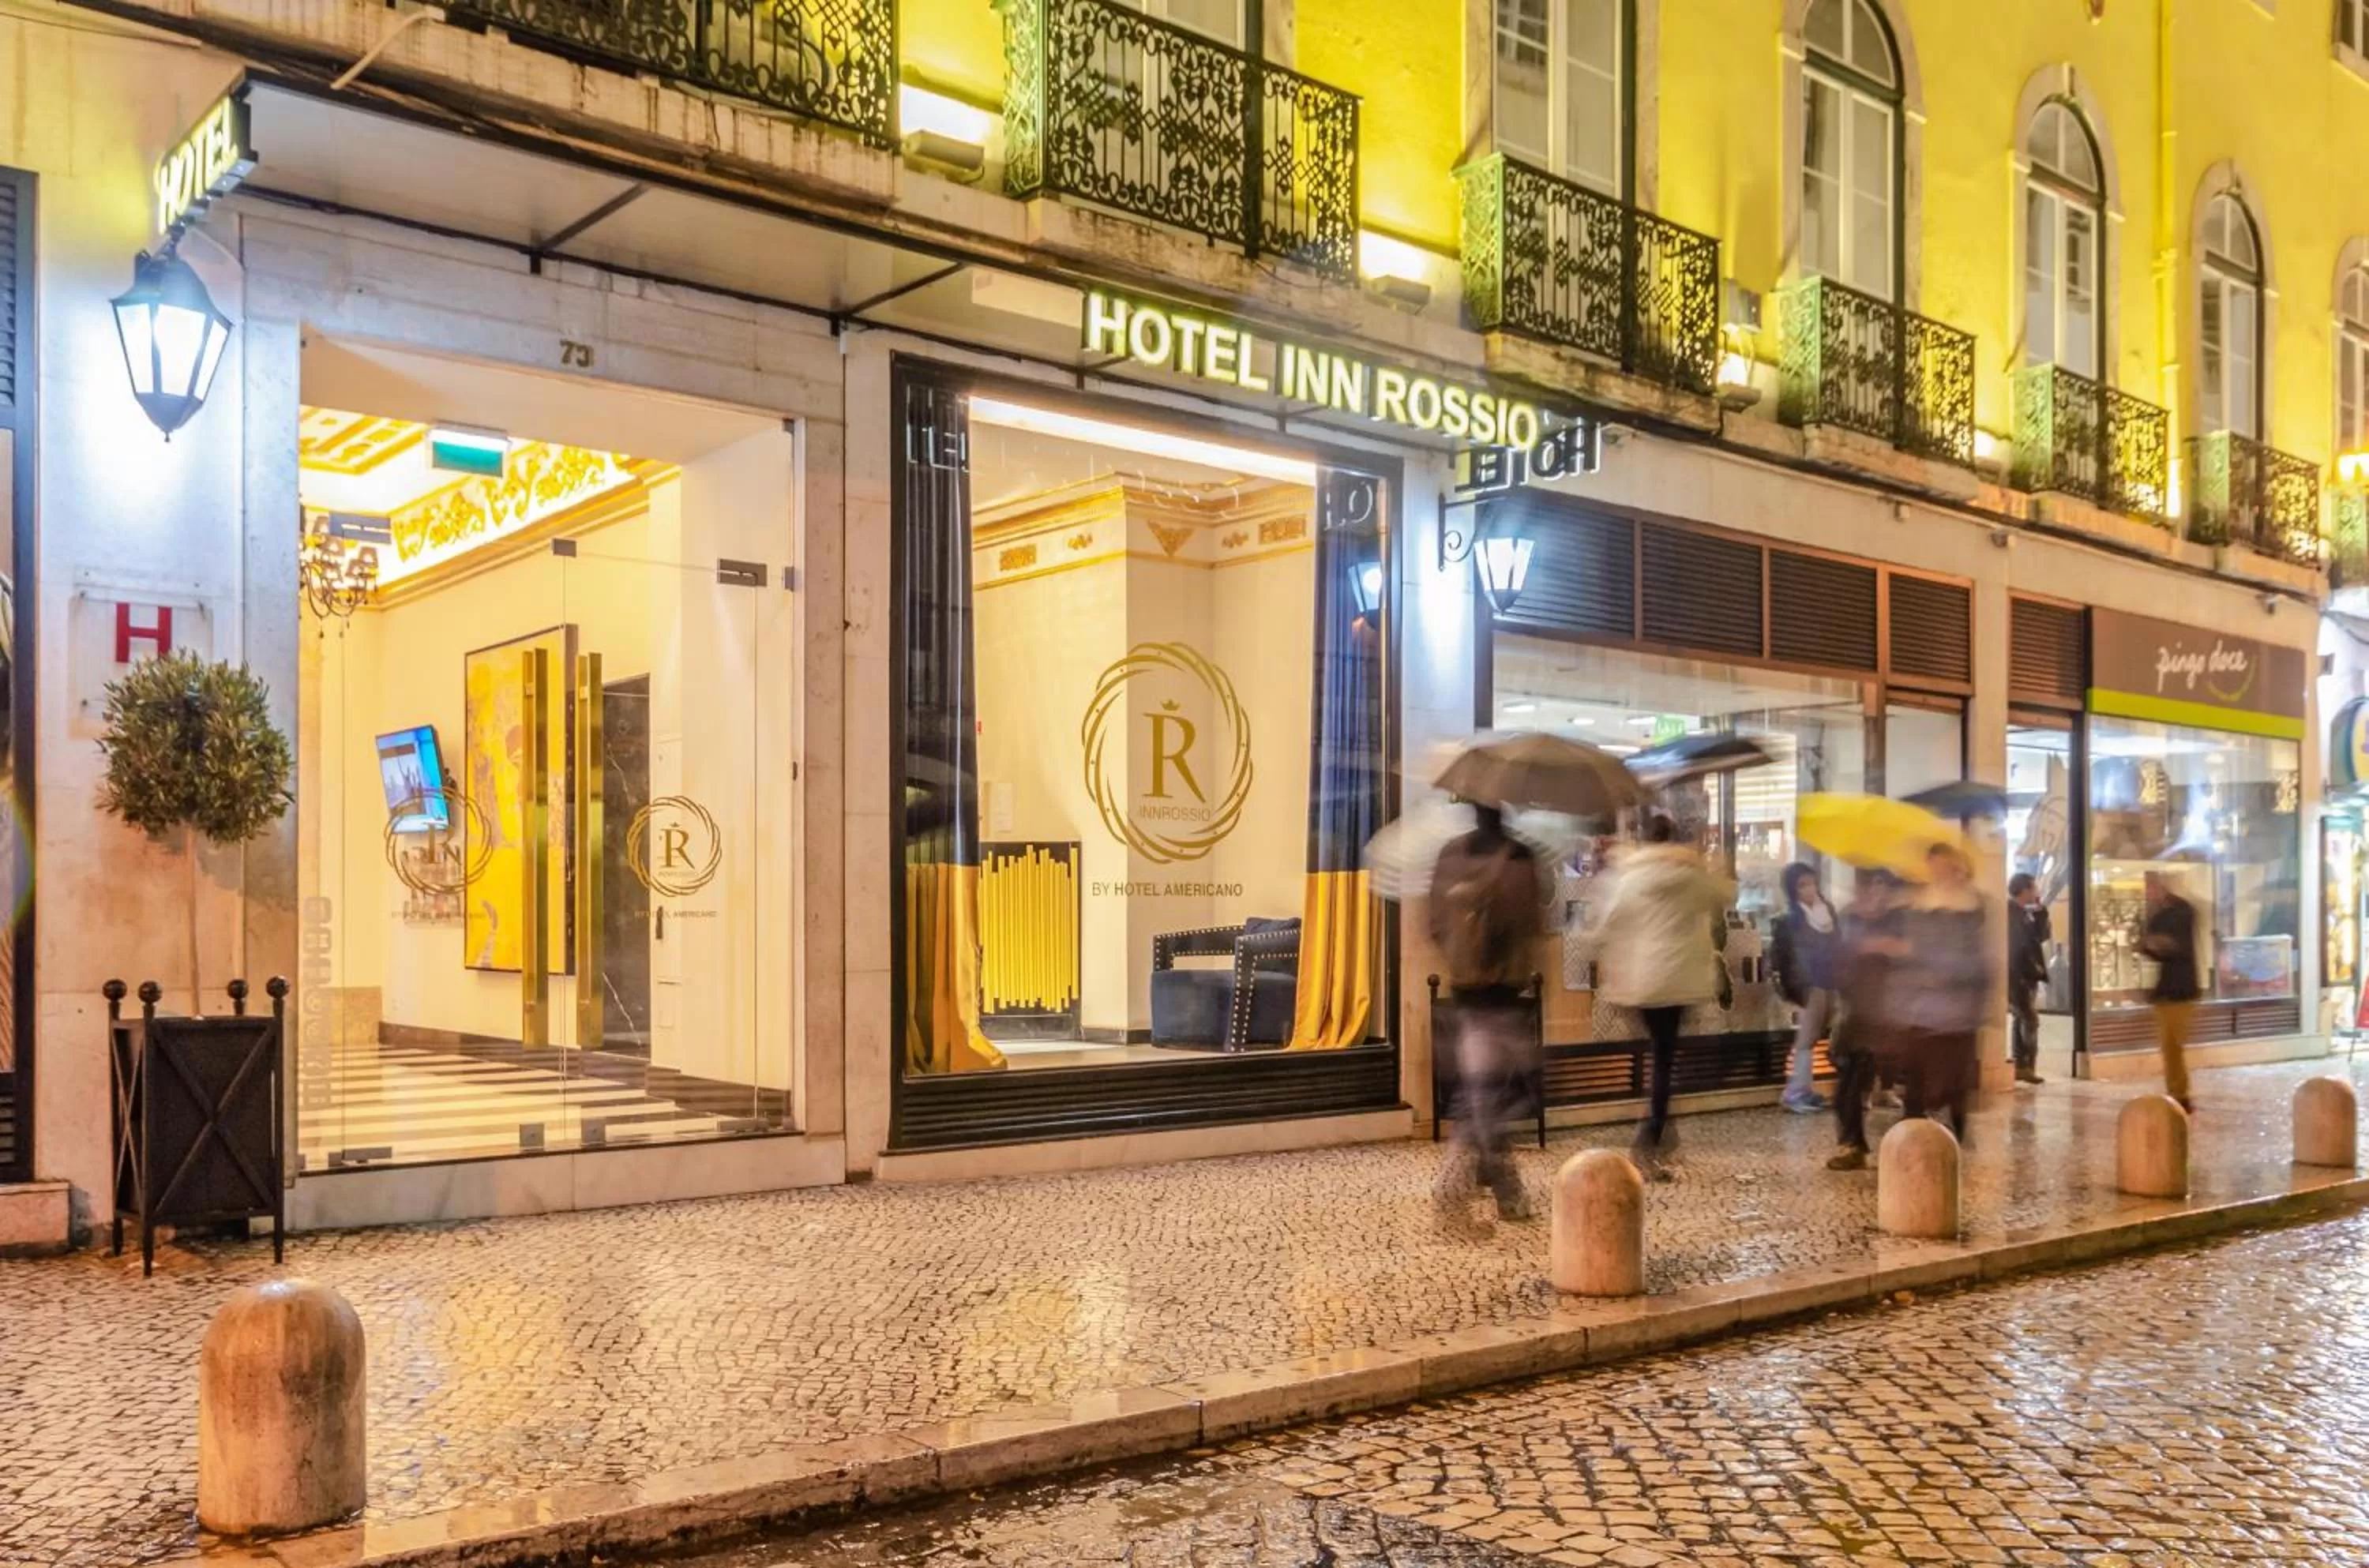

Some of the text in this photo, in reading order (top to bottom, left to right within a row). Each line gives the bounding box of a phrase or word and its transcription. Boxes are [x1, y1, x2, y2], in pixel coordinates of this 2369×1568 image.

[154, 96, 238, 234] HOTEL
[559, 339, 594, 367] 73
[1087, 291, 1539, 451] HOTEL INN ROSSIO
[115, 602, 172, 662] H
[2156, 639, 2248, 693] pingo doce
[1142, 712, 1207, 803] R
[1139, 805, 1211, 823] INNROSSIO
[659, 828, 696, 870] R
[1092, 883, 1244, 898] BY HOTEL AMERICANO
